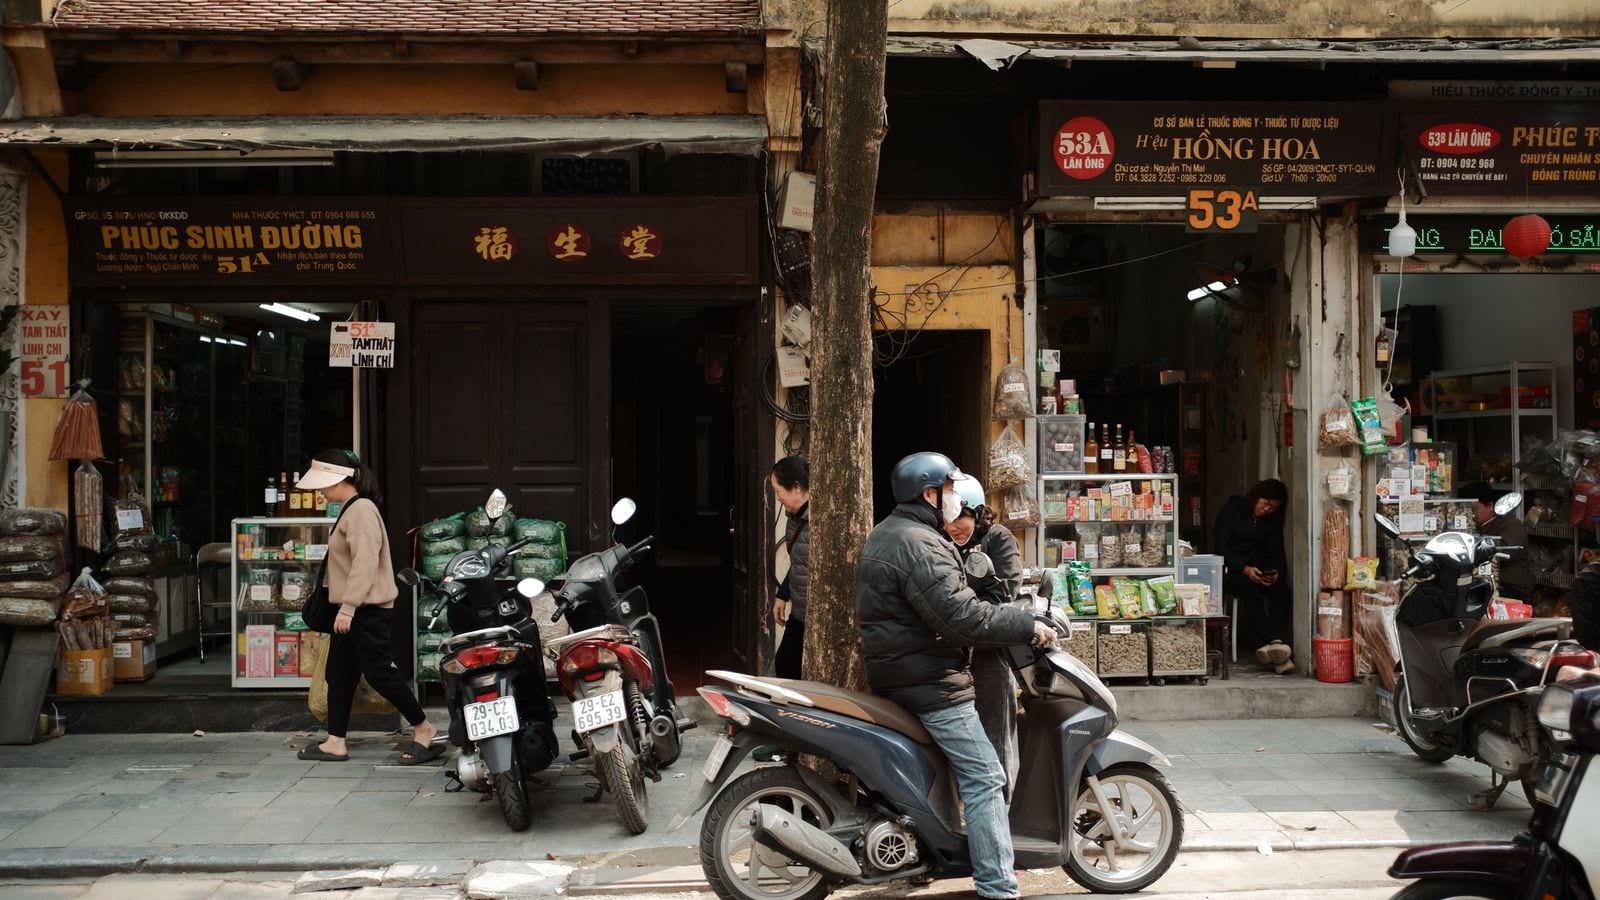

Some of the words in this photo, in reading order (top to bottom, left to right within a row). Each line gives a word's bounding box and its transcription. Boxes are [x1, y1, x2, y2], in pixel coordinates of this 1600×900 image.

[1467, 82, 1515, 96] THUỐC
[1058, 131, 1112, 155] 53A
[1172, 128, 1256, 160] HỒNG
[1261, 137, 1322, 160] HOA
[1470, 128, 1492, 147] ÔNG
[1511, 121, 1578, 147] PHÚC
[1584, 127, 1600, 147] T
[1063, 156, 1083, 169] LÃN
[1085, 156, 1105, 169] ÔNG
[1187, 189, 1259, 230] 53A
[100, 221, 180, 250] PHÚC
[185, 224, 254, 249] SINH
[259, 220, 363, 250] ĐƯỜNG
[217, 251, 271, 274] 51A
[22, 326, 42, 338] TAM
[22, 343, 44, 355] LINH
[46, 343, 62, 355] CHI
[1425, 519, 1432, 529] 4
[1455, 518, 1462, 528] 3
[470, 715, 515, 737] 034.03
[578, 706, 623, 730] 695.39
[776, 708, 837, 729] VISION
[1068, 728, 1091, 736] HONDA
